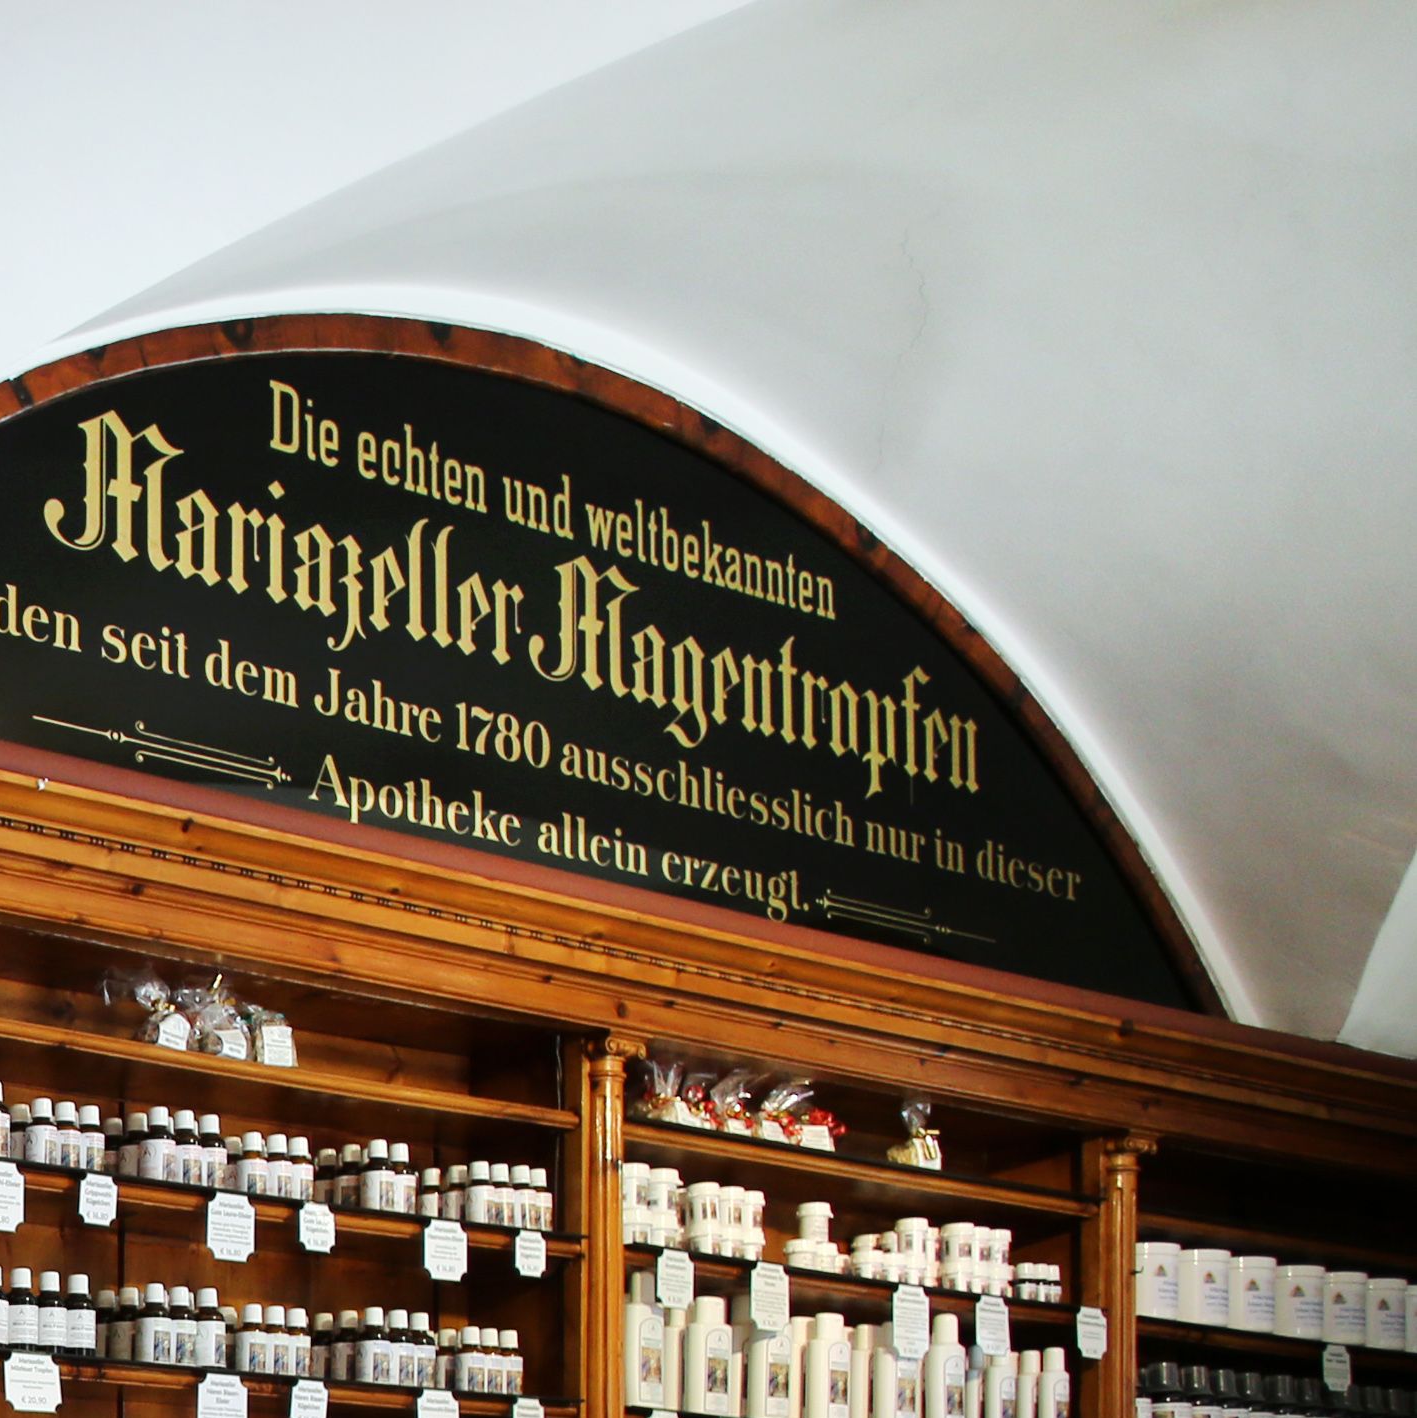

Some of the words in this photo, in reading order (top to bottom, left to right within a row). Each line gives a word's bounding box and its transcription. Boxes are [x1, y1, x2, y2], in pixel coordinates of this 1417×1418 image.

[44, 409, 524, 666] Mariazeller
[529, 555, 980, 801] Magentropfen
[269, 380, 340, 467] Die
[357, 424, 487, 514] echten
[503, 475, 573, 540] und
[586, 500, 836, 620] weltbekannten
[100, 625, 190, 679] seit
[204, 639, 300, 709] dem
[314, 667, 442, 743] Jahre
[455, 702, 551, 770] 1780
[560, 741, 854, 848] ausschliesslich
[865, 819, 927, 864] nur
[934, 829, 966, 874] in
[976, 839, 1082, 901] dieser
[308, 753, 522, 848] Apotheke
[537, 811, 648, 877] allein
[661, 851, 809, 922] erzeugt.
